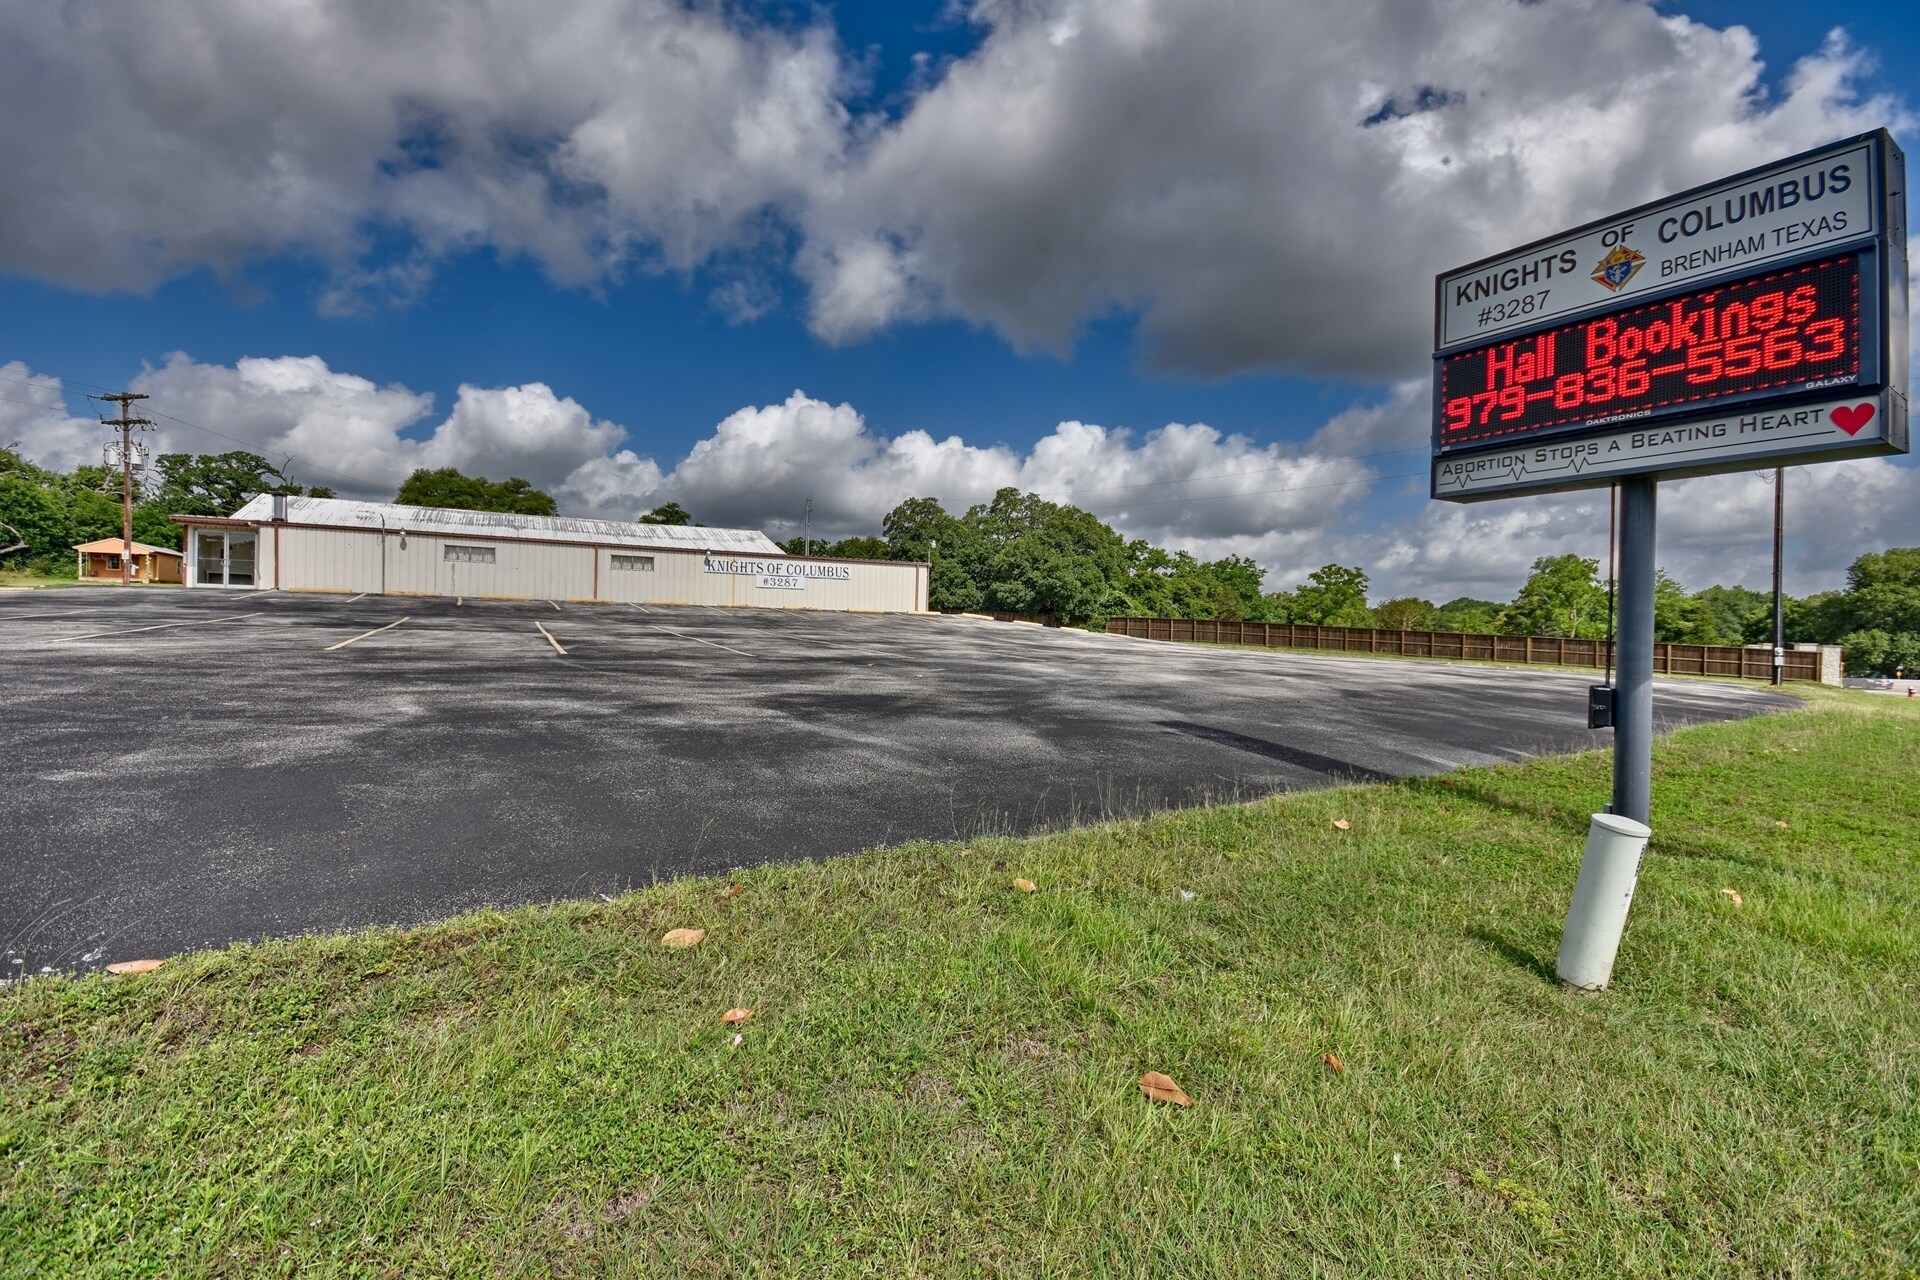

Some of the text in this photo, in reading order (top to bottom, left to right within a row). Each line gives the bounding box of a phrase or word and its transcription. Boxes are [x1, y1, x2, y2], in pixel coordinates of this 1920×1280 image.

[1455, 164, 1852, 306] KNIGHTS OF COLUMBUS
[1660, 211, 1848, 278] BRENHAM TEXAS
[1477, 290, 1551, 327] #3287
[1486, 284, 1817, 391] Hall Bookings
[1446, 317, 1846, 431] 979-836-5563
[1805, 375, 1857, 389] GALAXY
[1586, 409, 1652, 426] DAKTRONICS
[1608, 440, 1621, 453] A
[707, 560, 850, 578] KNIGHTS OF COLUMBUS
[763, 577, 798, 587] #3287
